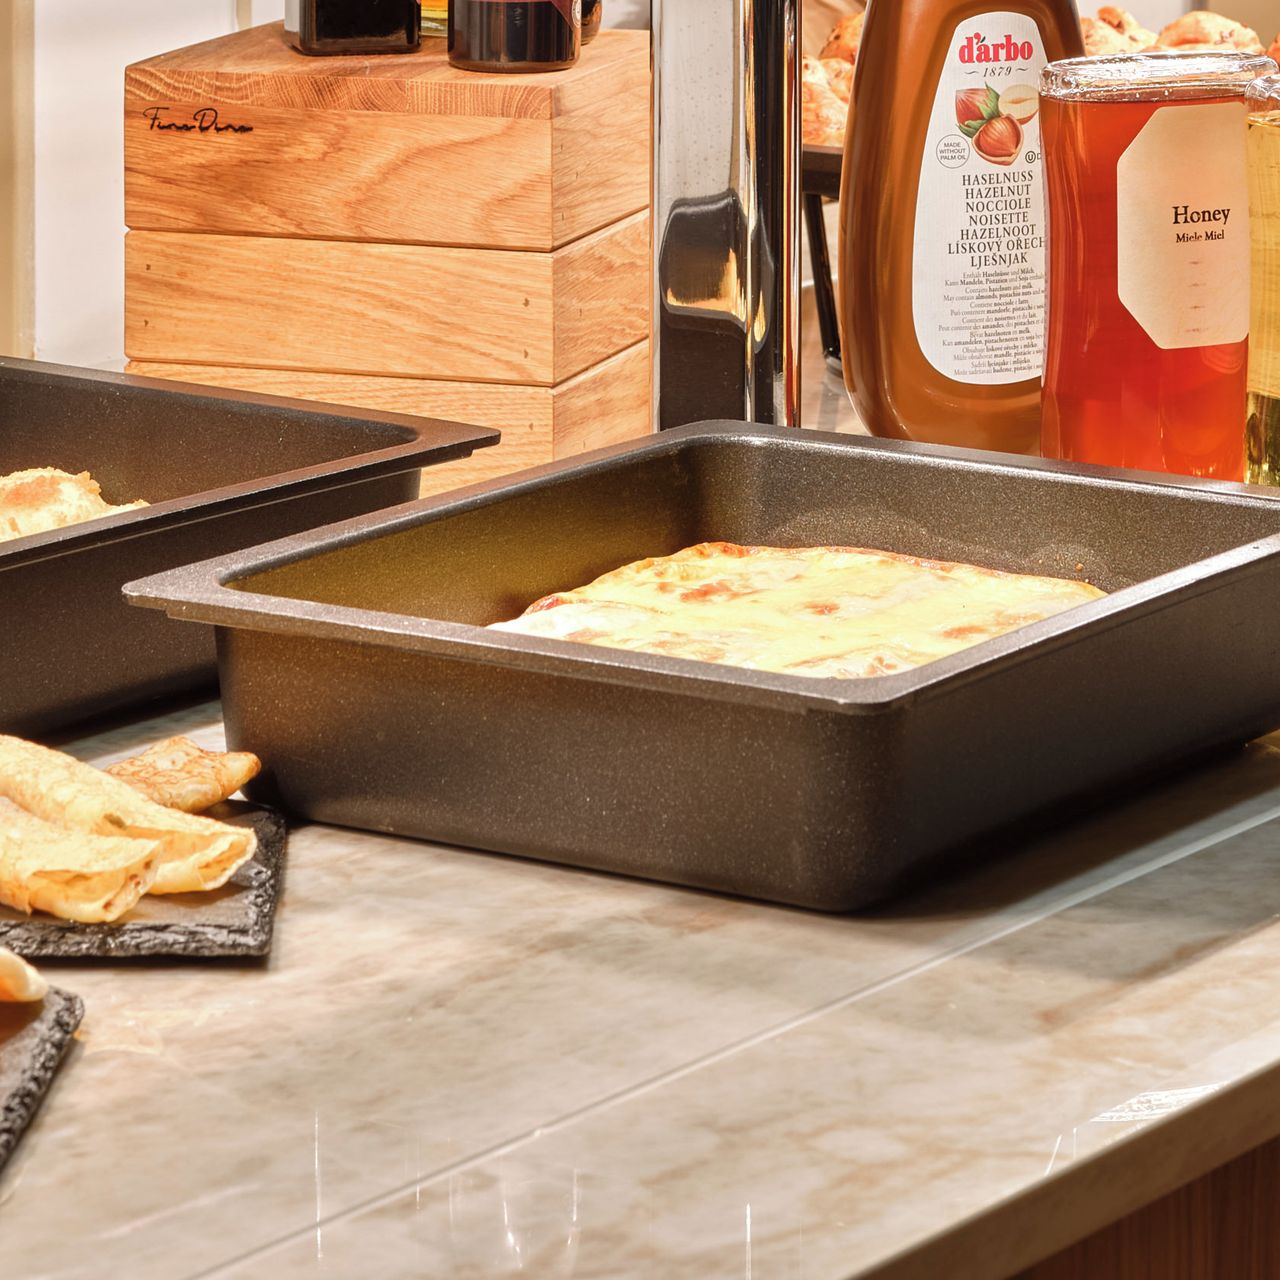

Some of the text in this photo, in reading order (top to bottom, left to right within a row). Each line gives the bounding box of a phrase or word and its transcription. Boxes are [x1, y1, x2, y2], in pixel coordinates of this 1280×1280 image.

[983, 66, 1012, 78] 1879
[962, 170, 1033, 186] HASELNUSS
[965, 184, 1031, 199] HAZELNUT
[965, 198, 1031, 213] NOCCIOLE
[969, 211, 1028, 226] NOISETTE
[1172, 205, 1230, 225] Honey
[960, 224, 1036, 240] HAZELNOOT
[1205, 230, 1224, 241] Miel
[948, 238, 1002, 254] LÍSKOVÝ
[971, 252, 1028, 269] LJEŠNJAK
